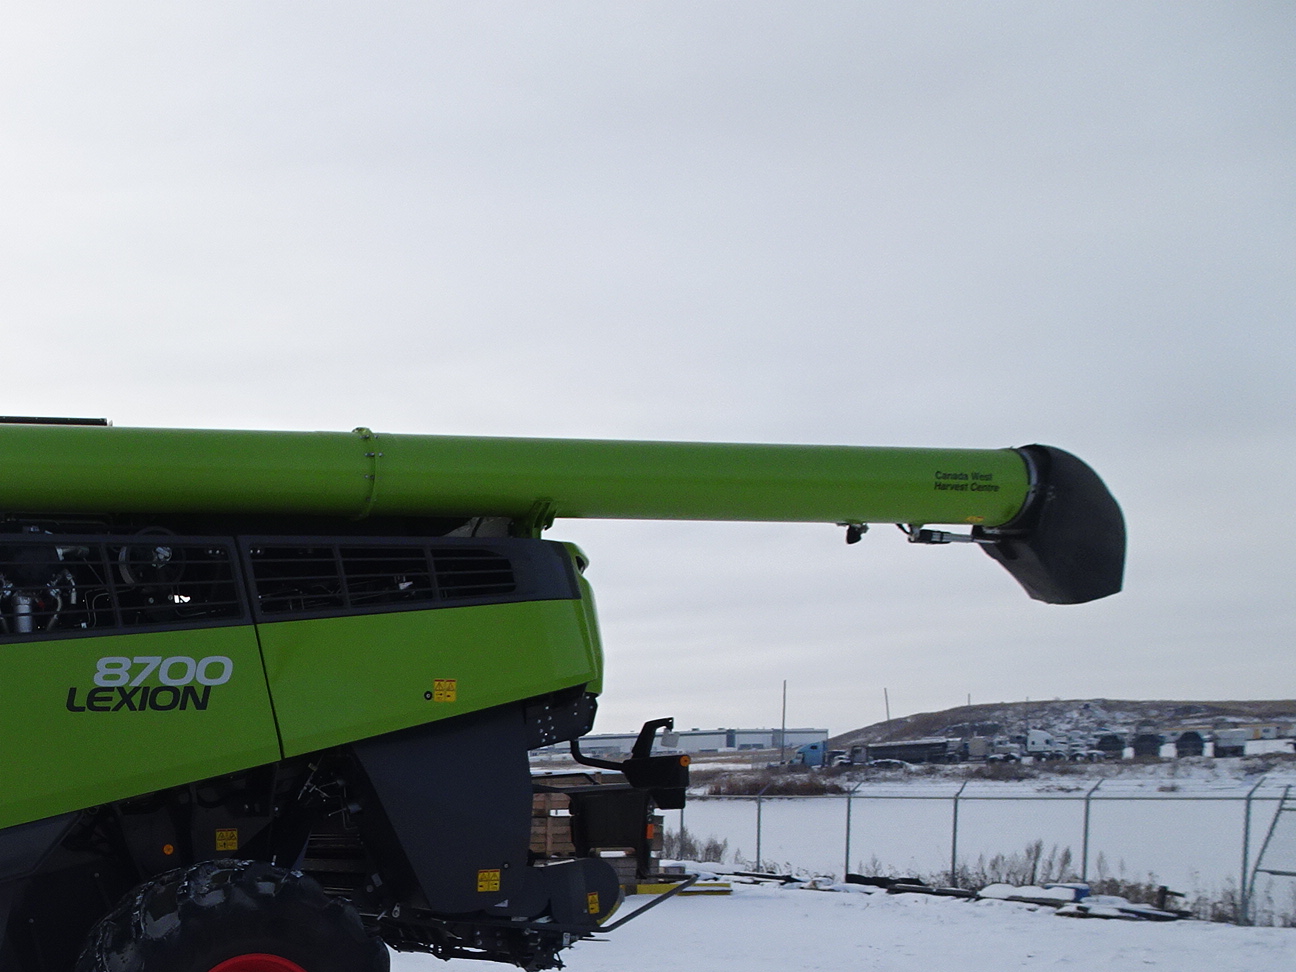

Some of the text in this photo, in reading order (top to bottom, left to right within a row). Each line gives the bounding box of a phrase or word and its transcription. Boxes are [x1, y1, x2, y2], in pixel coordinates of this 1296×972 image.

[935, 470, 993, 481] Canada West
[934, 481, 1000, 492] Harvest Centre
[93, 655, 234, 687] 8700
[65, 685, 212, 713] LEXION
